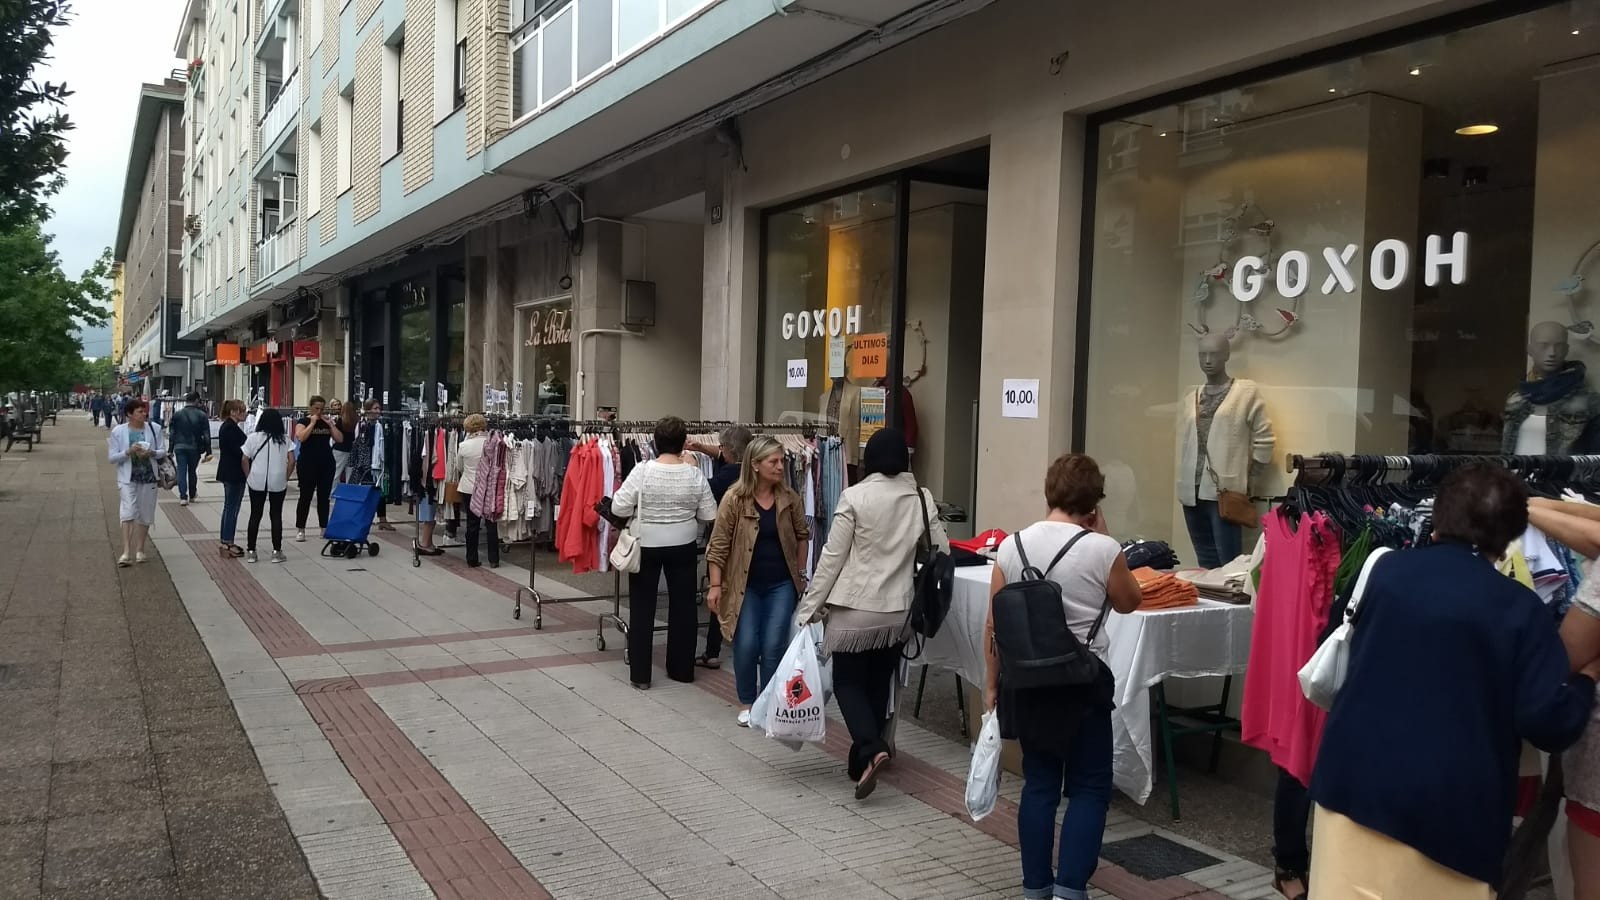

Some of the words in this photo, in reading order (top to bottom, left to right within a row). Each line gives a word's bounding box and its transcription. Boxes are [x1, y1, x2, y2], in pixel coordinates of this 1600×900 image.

[1232, 231, 1468, 302] GOXOH
[524, 310, 541, 347] La
[782, 304, 862, 340] GOXOH
[854, 338, 887, 350] ULTIMOS
[861, 355, 879, 365] DIAS
[775, 706, 820, 719] LAUDIO
